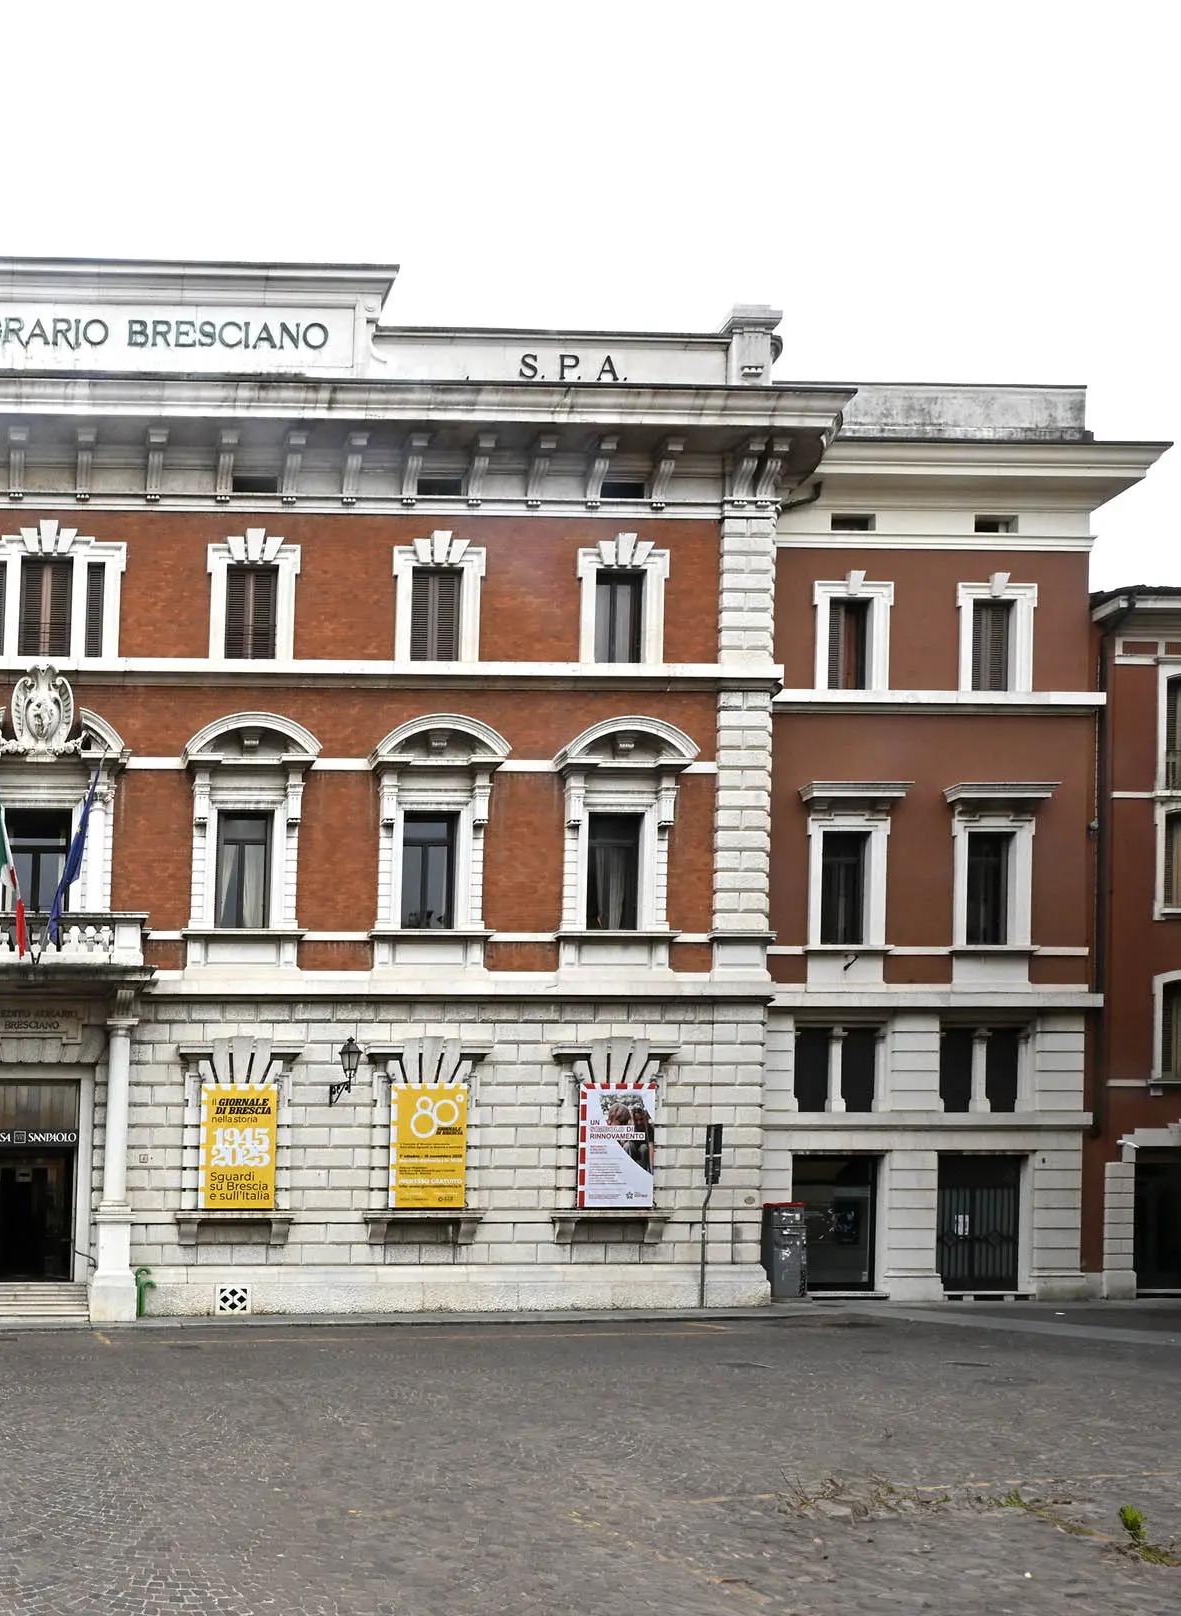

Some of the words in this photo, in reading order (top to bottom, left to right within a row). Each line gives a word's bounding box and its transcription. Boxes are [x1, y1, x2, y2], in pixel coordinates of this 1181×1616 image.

[127, 319, 330, 350] BRESCIANO
[5, 1020, 60, 1030] BRESCIANO
[218, 1098, 270, 1106] GIORNALE
[215, 1106, 227, 1114] DI
[228, 1106, 272, 1115] BRESCIA
[211, 1115, 233, 1123] nella
[233, 1115, 258, 1123] storia
[28, 1132, 77, 1142] SANPAOLO
[212, 1127, 270, 1148] 1945
[210, 1146, 271, 1168] 2025
[210, 1171, 255, 1183] Sguardi
[226, 1181, 268, 1190] Brescia
[209, 1192, 217, 1200] e
[219, 1191, 270, 1200] sull'Italia
